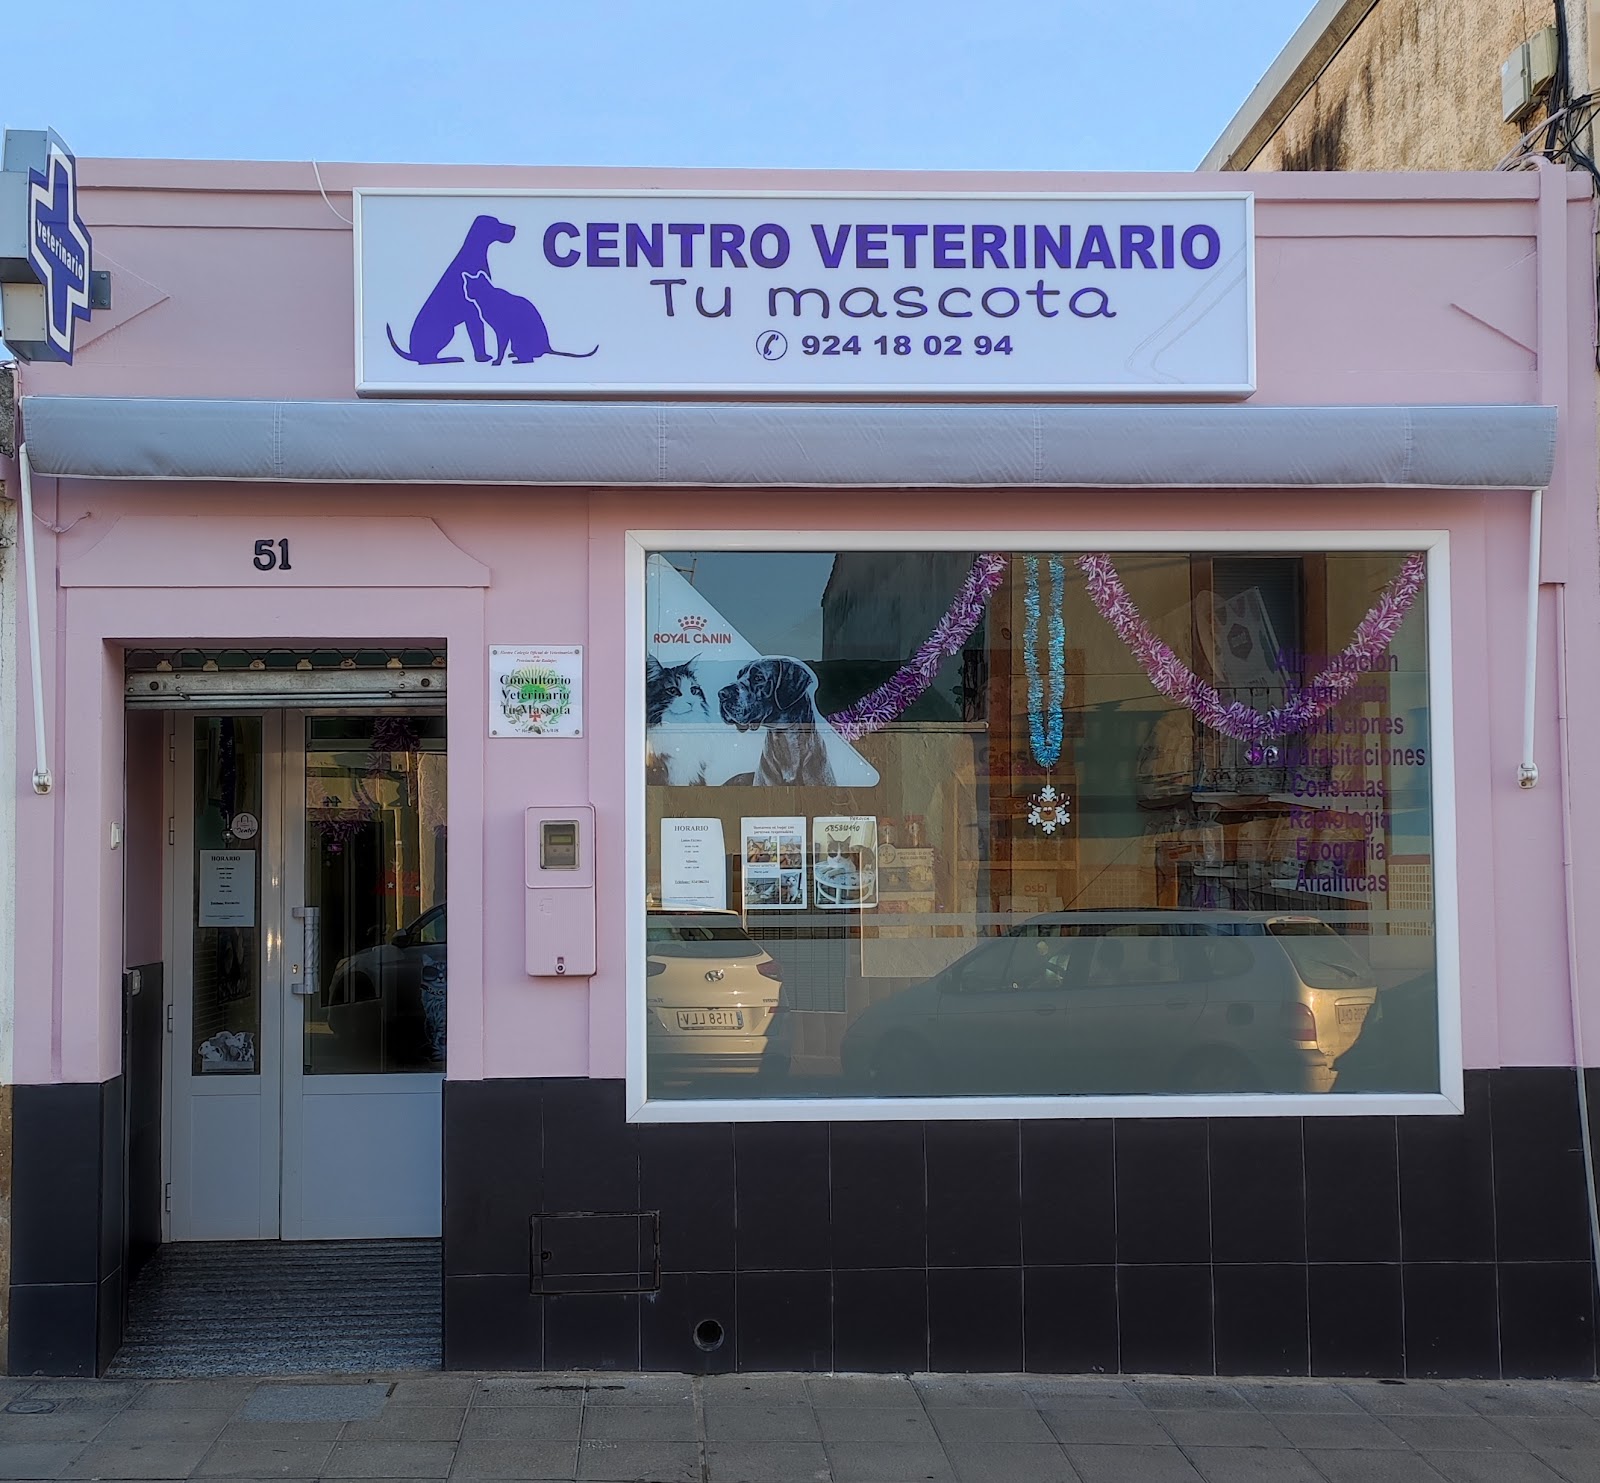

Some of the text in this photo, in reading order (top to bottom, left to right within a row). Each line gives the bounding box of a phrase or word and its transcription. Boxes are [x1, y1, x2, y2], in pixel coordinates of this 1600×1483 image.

[36, 218, 84, 281] veterinario
[542, 221, 1221, 270] CENTRO VETERINARIO
[649, 277, 1117, 319] Tu mascota
[801, 335, 1014, 356] 924 18 02 94
[253, 538, 292, 571] 51
[653, 633, 732, 644] ROYAL CANIN
[1275, 649, 1398, 672] Alimnación
[500, 675, 571, 685] Consultorio
[501, 689, 570, 700] Veterinario
[1250, 743, 1426, 769] Dearasitaciones
[1292, 774, 1386, 798] Consultas
[1290, 805, 1390, 834] Radiología
[1296, 836, 1386, 865] Ecografía
[1295, 869, 1389, 892] Analíticas
